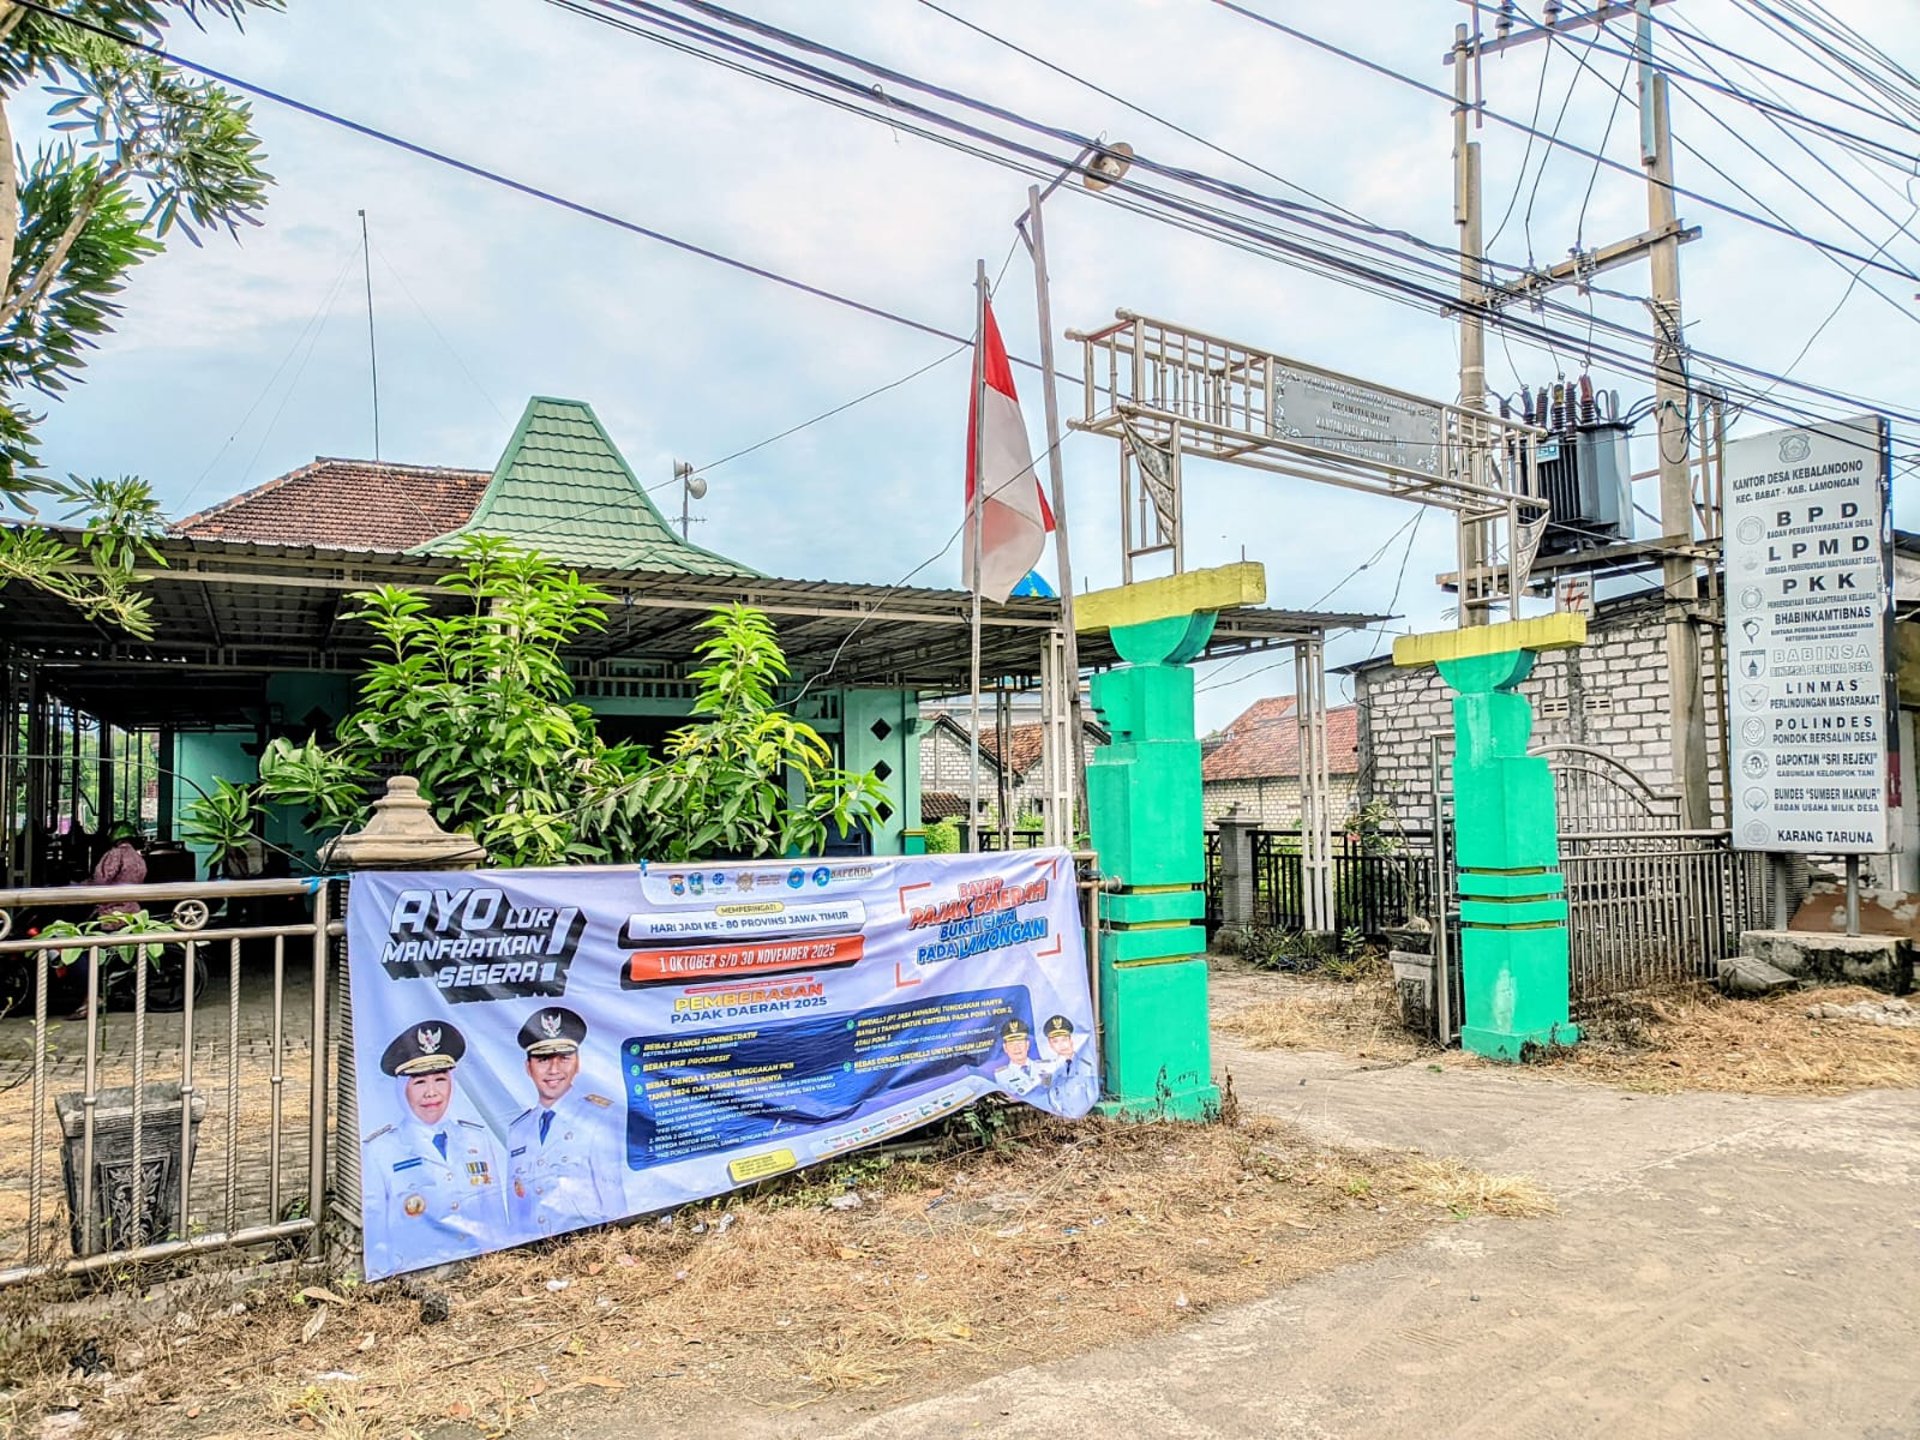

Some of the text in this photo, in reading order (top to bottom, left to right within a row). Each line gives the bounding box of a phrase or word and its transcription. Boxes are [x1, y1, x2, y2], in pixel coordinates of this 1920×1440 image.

[1733, 460, 1863, 490] KANTOR DESA KEBALANDONO
[1736, 492, 1753, 504] KEC.
[1755, 488, 1779, 501] BABAT
[1787, 484, 1806, 496] KAB.
[1809, 477, 1859, 492] LAMONGAN
[1767, 529, 1787, 539] BADAN
[1855, 519, 1873, 528] DESA
[1775, 606, 1871, 625] BHABINKAMTIBNAS
[1773, 644, 1870, 663] BABINSA
[1848, 661, 1874, 673] DESA
[1786, 679, 1858, 694] LINMAS
[1770, 695, 1880, 709] PERLINDUNGAN MASYARAKAT
[1775, 716, 1873, 730] POLINDES
[1773, 732, 1877, 744] PONDOK BERSALIN DESA
[1776, 754, 1819, 766] GAPOKTAN
[1774, 788, 1804, 800] BUMDES
[1778, 830, 1873, 843] KARANG TARUNA
[958, 876, 1004, 898] BAYAR
[390, 888, 556, 934] AYO LUR
[721, 904, 777, 914] MEMPERINGATI
[908, 878, 1048, 930] PAJAK DAERAH
[650, 923, 677, 934] HARI
[679, 922, 702, 932] JADI
[704, 920, 718, 930] KE
[726, 919, 738, 929] 80
[742, 916, 787, 928] PROVINSI
[789, 914, 816, 924] JAWA
[819, 912, 849, 922] TIMUR
[940, 918, 979, 940] BUKTI
[382, 934, 546, 963] MANFAATKAN
[917, 917, 1047, 964] PADA LAMONGAN
[660, 943, 836, 972] 1 OKTOBER S/D 30 NOVEMBER 2025
[437, 961, 536, 988] SEGERA
[671, 997, 828, 1024] PAJAK DAERAH 2025
[643, 1062, 668, 1072] BEBAS
[646, 1080, 670, 1090] BEBAS
[671, 1076, 699, 1086] DENDA
[707, 1070, 732, 1080] POKOK
[733, 1064, 779, 1076] TUNGGAKAN
[692, 1083, 710, 1093] DAN
